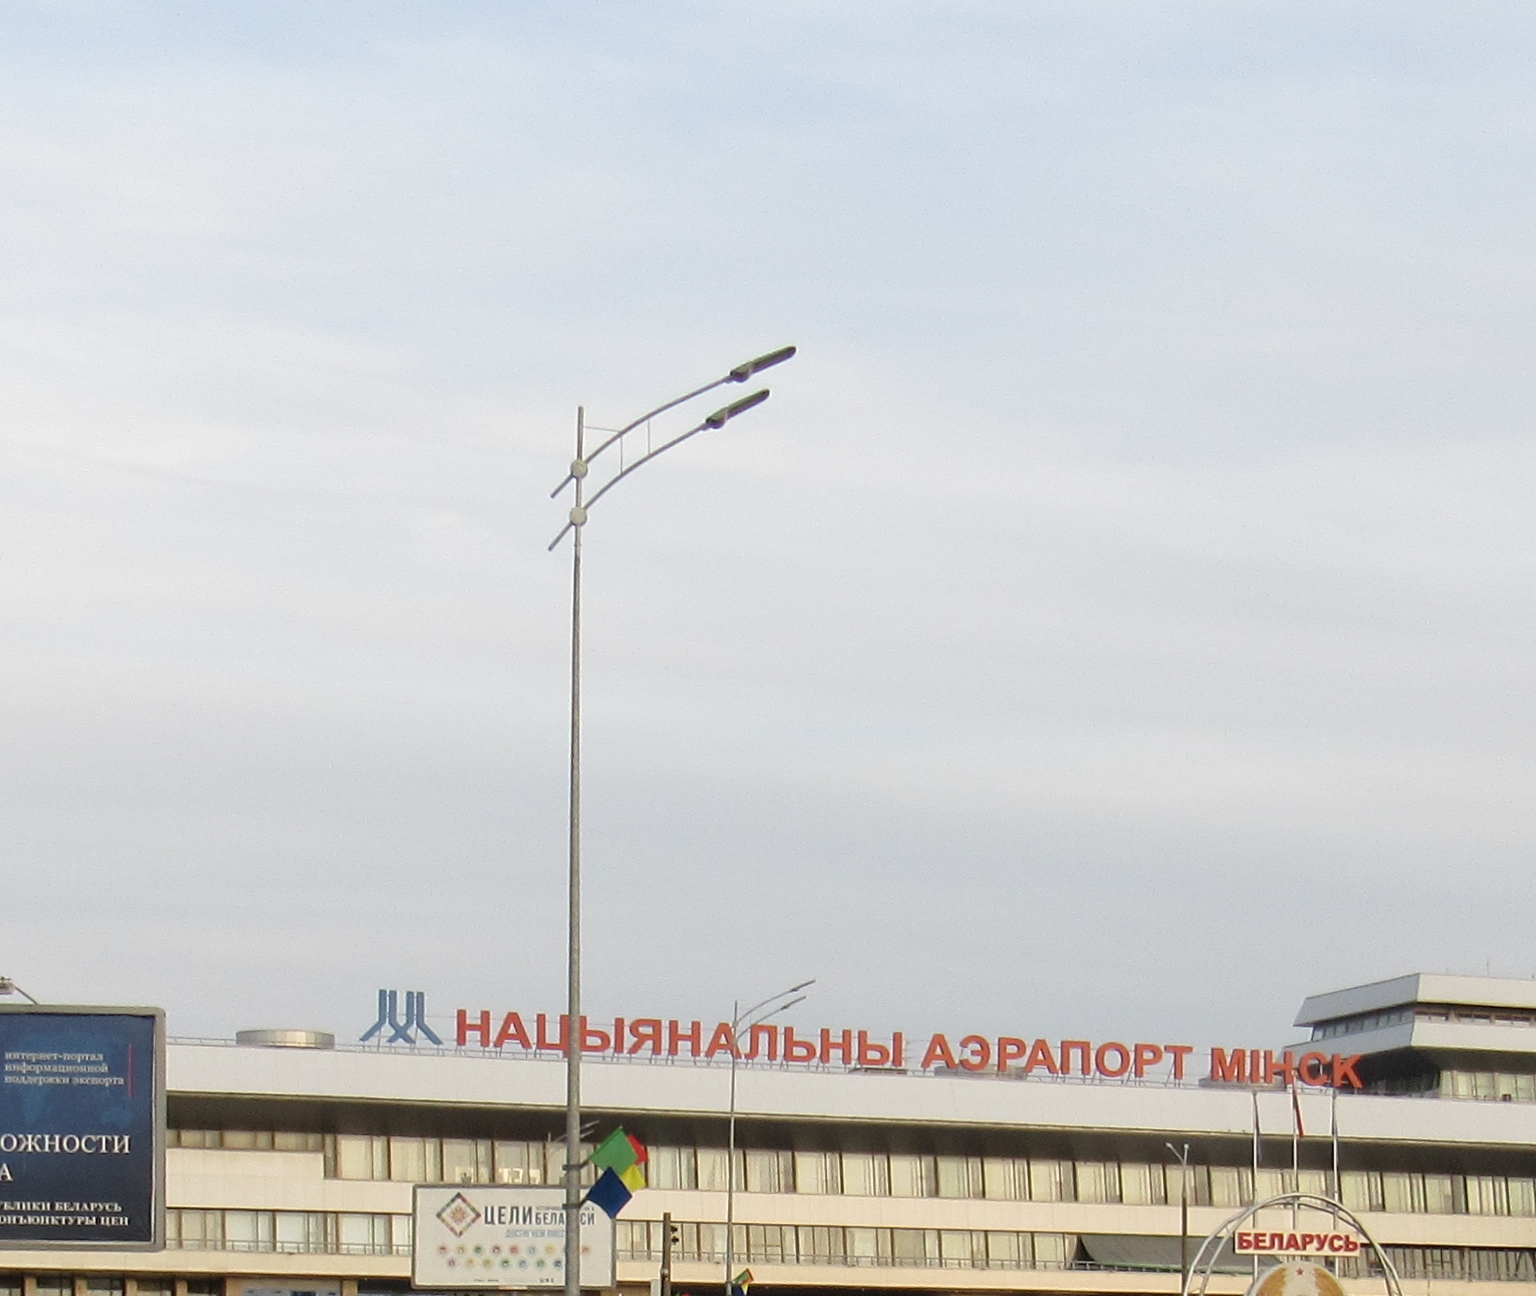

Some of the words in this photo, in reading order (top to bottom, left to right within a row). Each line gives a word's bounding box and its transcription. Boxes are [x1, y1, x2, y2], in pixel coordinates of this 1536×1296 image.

[456, 1008, 903, 1068] НАЦЫЯНАЛЬНЫ
[920, 1032, 1194, 1081] АЭРАПОРТ
[1210, 1046, 1364, 1090] МІНСК
[4, 1051, 104, 1064] интернет-портал
[4, 1061, 110, 1074] информационной
[4, 1075, 70, 1086] поддержки
[72, 1076, 125, 1088] экспорта
[54, 1201, 123, 1213] БЕЛАРУСЬ
[100, 1216, 129, 1228] ЦЕН
[484, 1205, 533, 1226] ЦЕЛИ
[535, 1211, 595, 1226] БЕЛАСИ
[1237, 1231, 1359, 1253] БЕЛАРУСЬ
